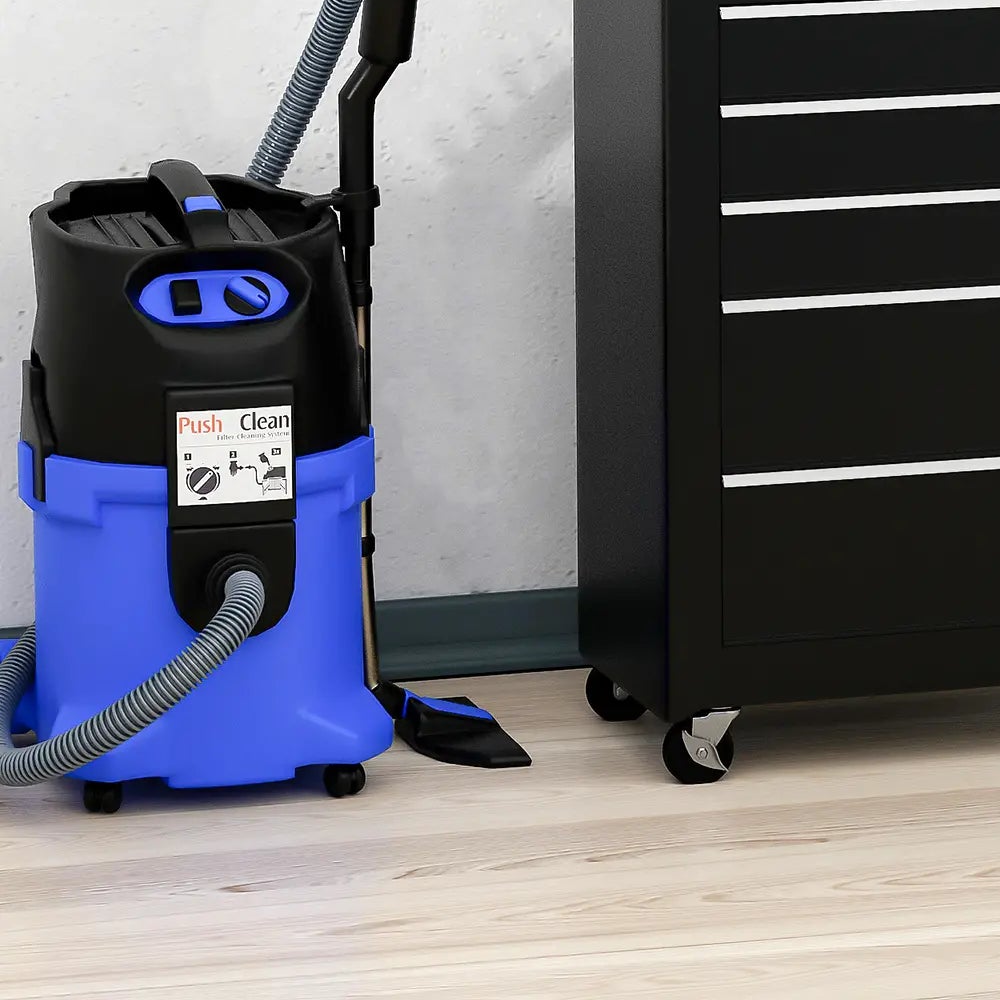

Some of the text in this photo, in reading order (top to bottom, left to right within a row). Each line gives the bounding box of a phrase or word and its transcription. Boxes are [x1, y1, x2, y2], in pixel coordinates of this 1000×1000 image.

[178, 412, 290, 434] Push Clean
[236, 432, 266, 440] Cleaning
